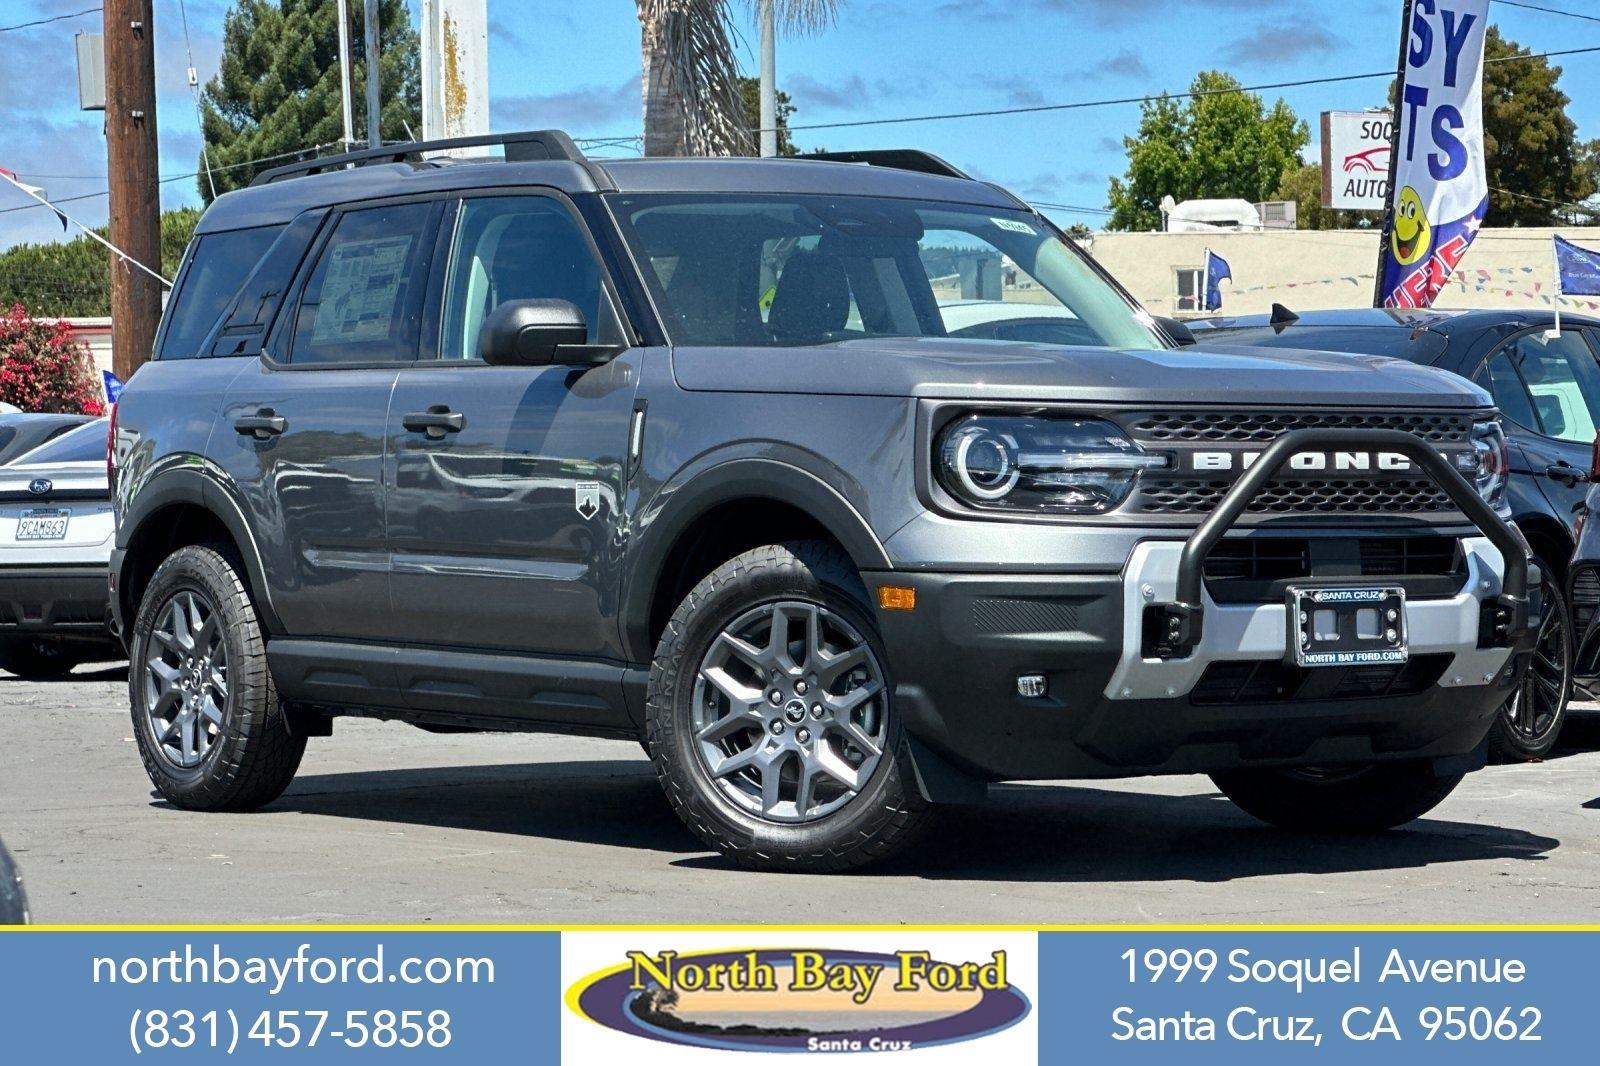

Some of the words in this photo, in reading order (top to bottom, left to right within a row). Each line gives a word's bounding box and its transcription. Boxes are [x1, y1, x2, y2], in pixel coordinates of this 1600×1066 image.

[1343, 179, 1387, 198] AUTO
[1193, 452, 1448, 470] BONC
[1322, 591, 1352, 600] SANTA
[1353, 591, 1379, 599] CRUZ
[1305, 654, 1336, 663] NORTH
[1338, 653, 1355, 662] BAY
[1356, 651, 1402, 661] FORD.COM
